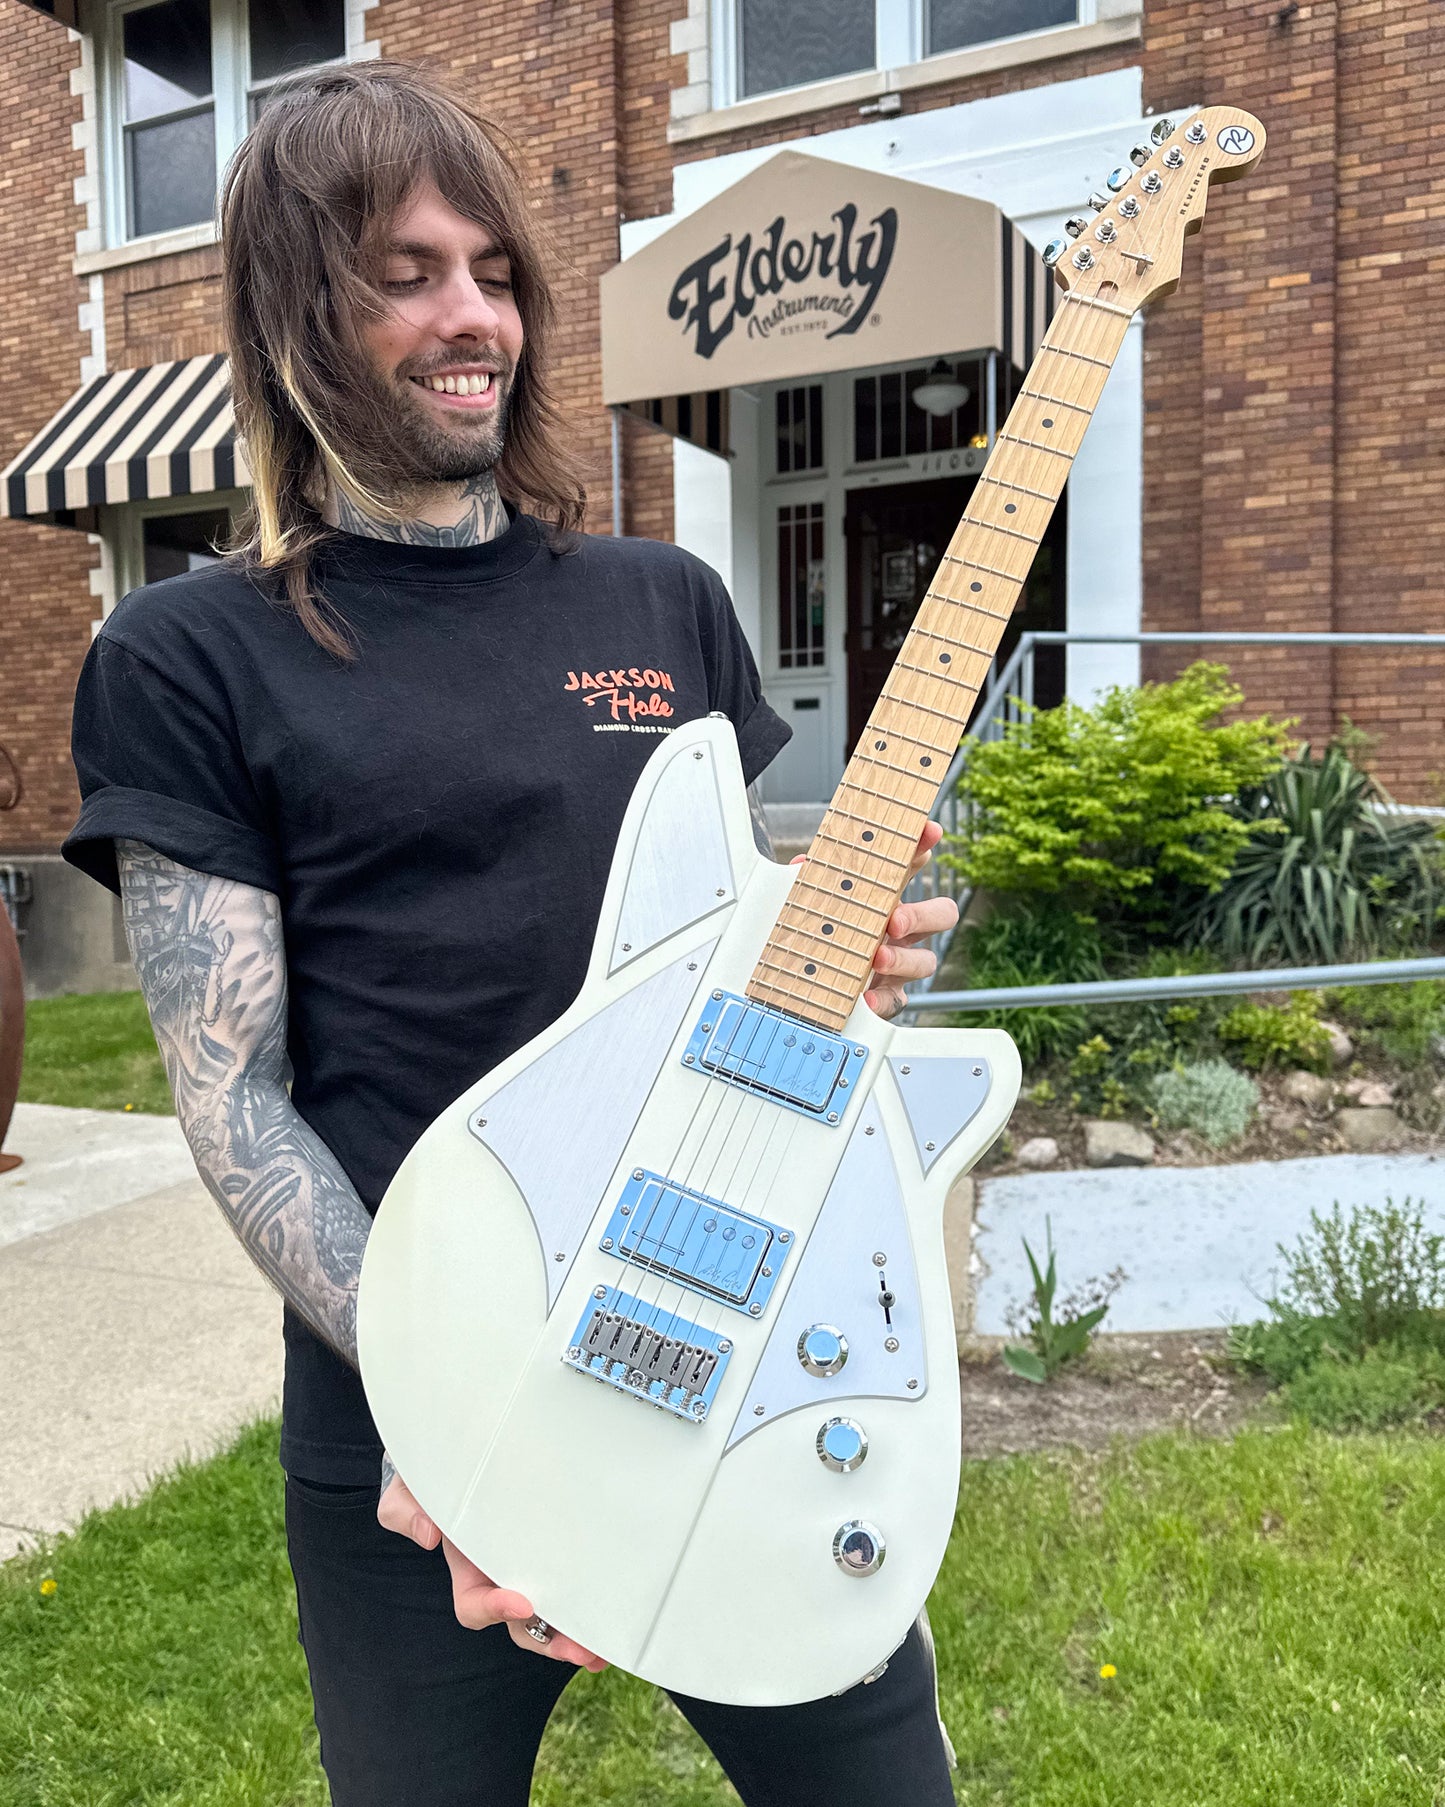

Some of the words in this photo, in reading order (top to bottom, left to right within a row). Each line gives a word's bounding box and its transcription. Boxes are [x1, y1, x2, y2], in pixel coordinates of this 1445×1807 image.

[1179, 156, 1210, 215] REVEREND
[667, 203, 898, 359] Elderly
[747, 294, 855, 339] Instruments
[922, 451, 976, 473] 1100
[563, 667, 676, 693] JACKSON
[582, 688, 675, 722] Hole
[593, 723, 631, 732] DIAMOND
